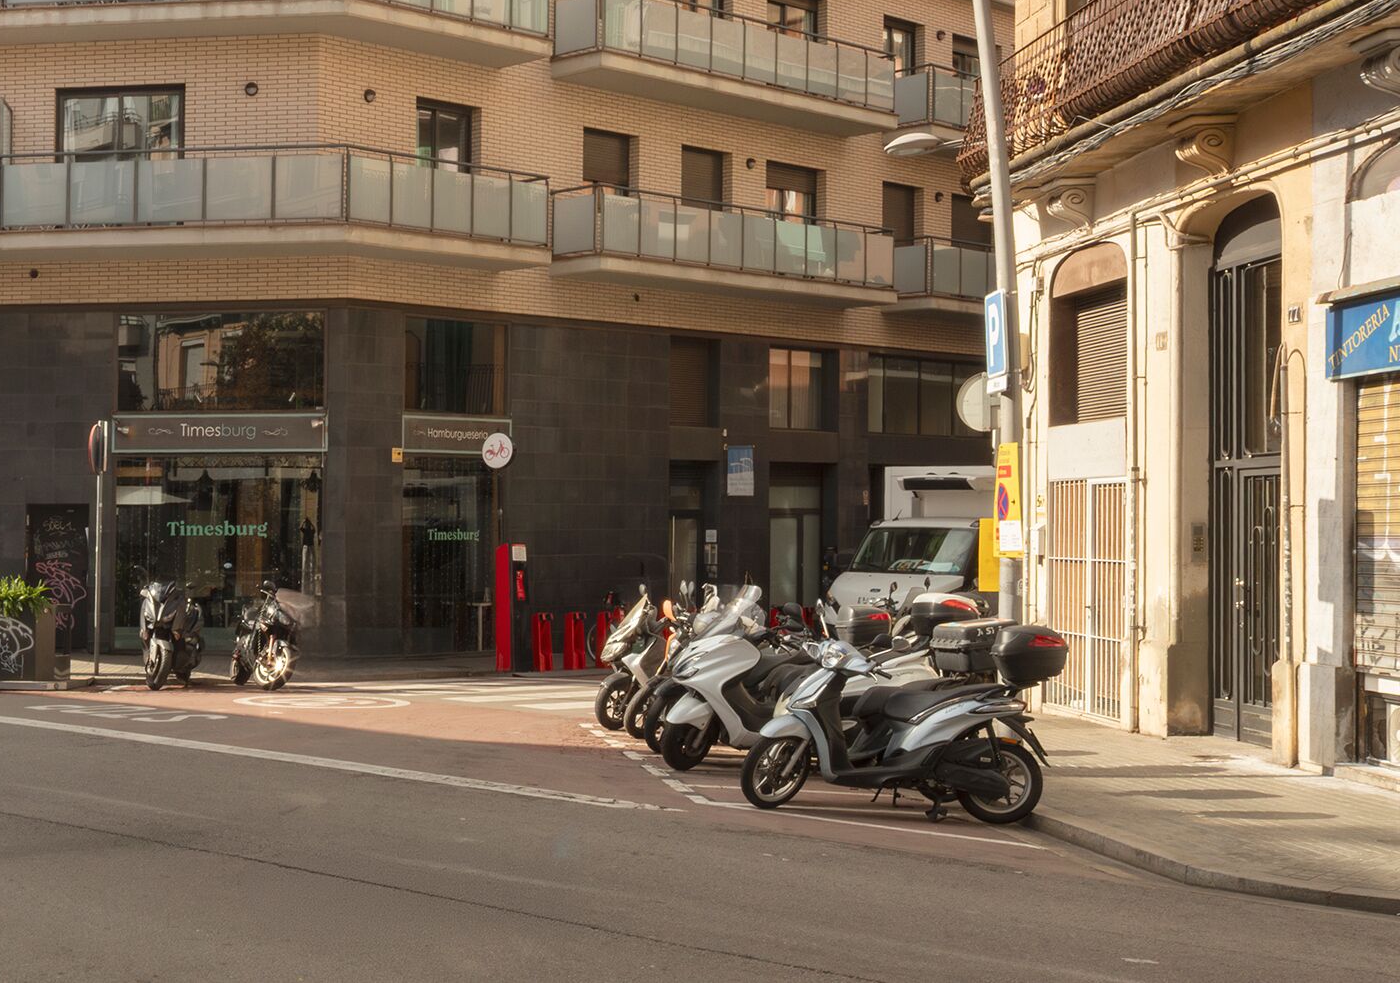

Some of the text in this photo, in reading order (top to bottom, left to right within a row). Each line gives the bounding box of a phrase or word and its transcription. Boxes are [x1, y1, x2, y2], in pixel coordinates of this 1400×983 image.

[987, 302, 1000, 367] P
[1328, 303, 1390, 370] TINTORERIA
[180, 423, 256, 440] Timesburg
[166, 520, 268, 538] Timesburg
[427, 528, 480, 542] Timesburg
